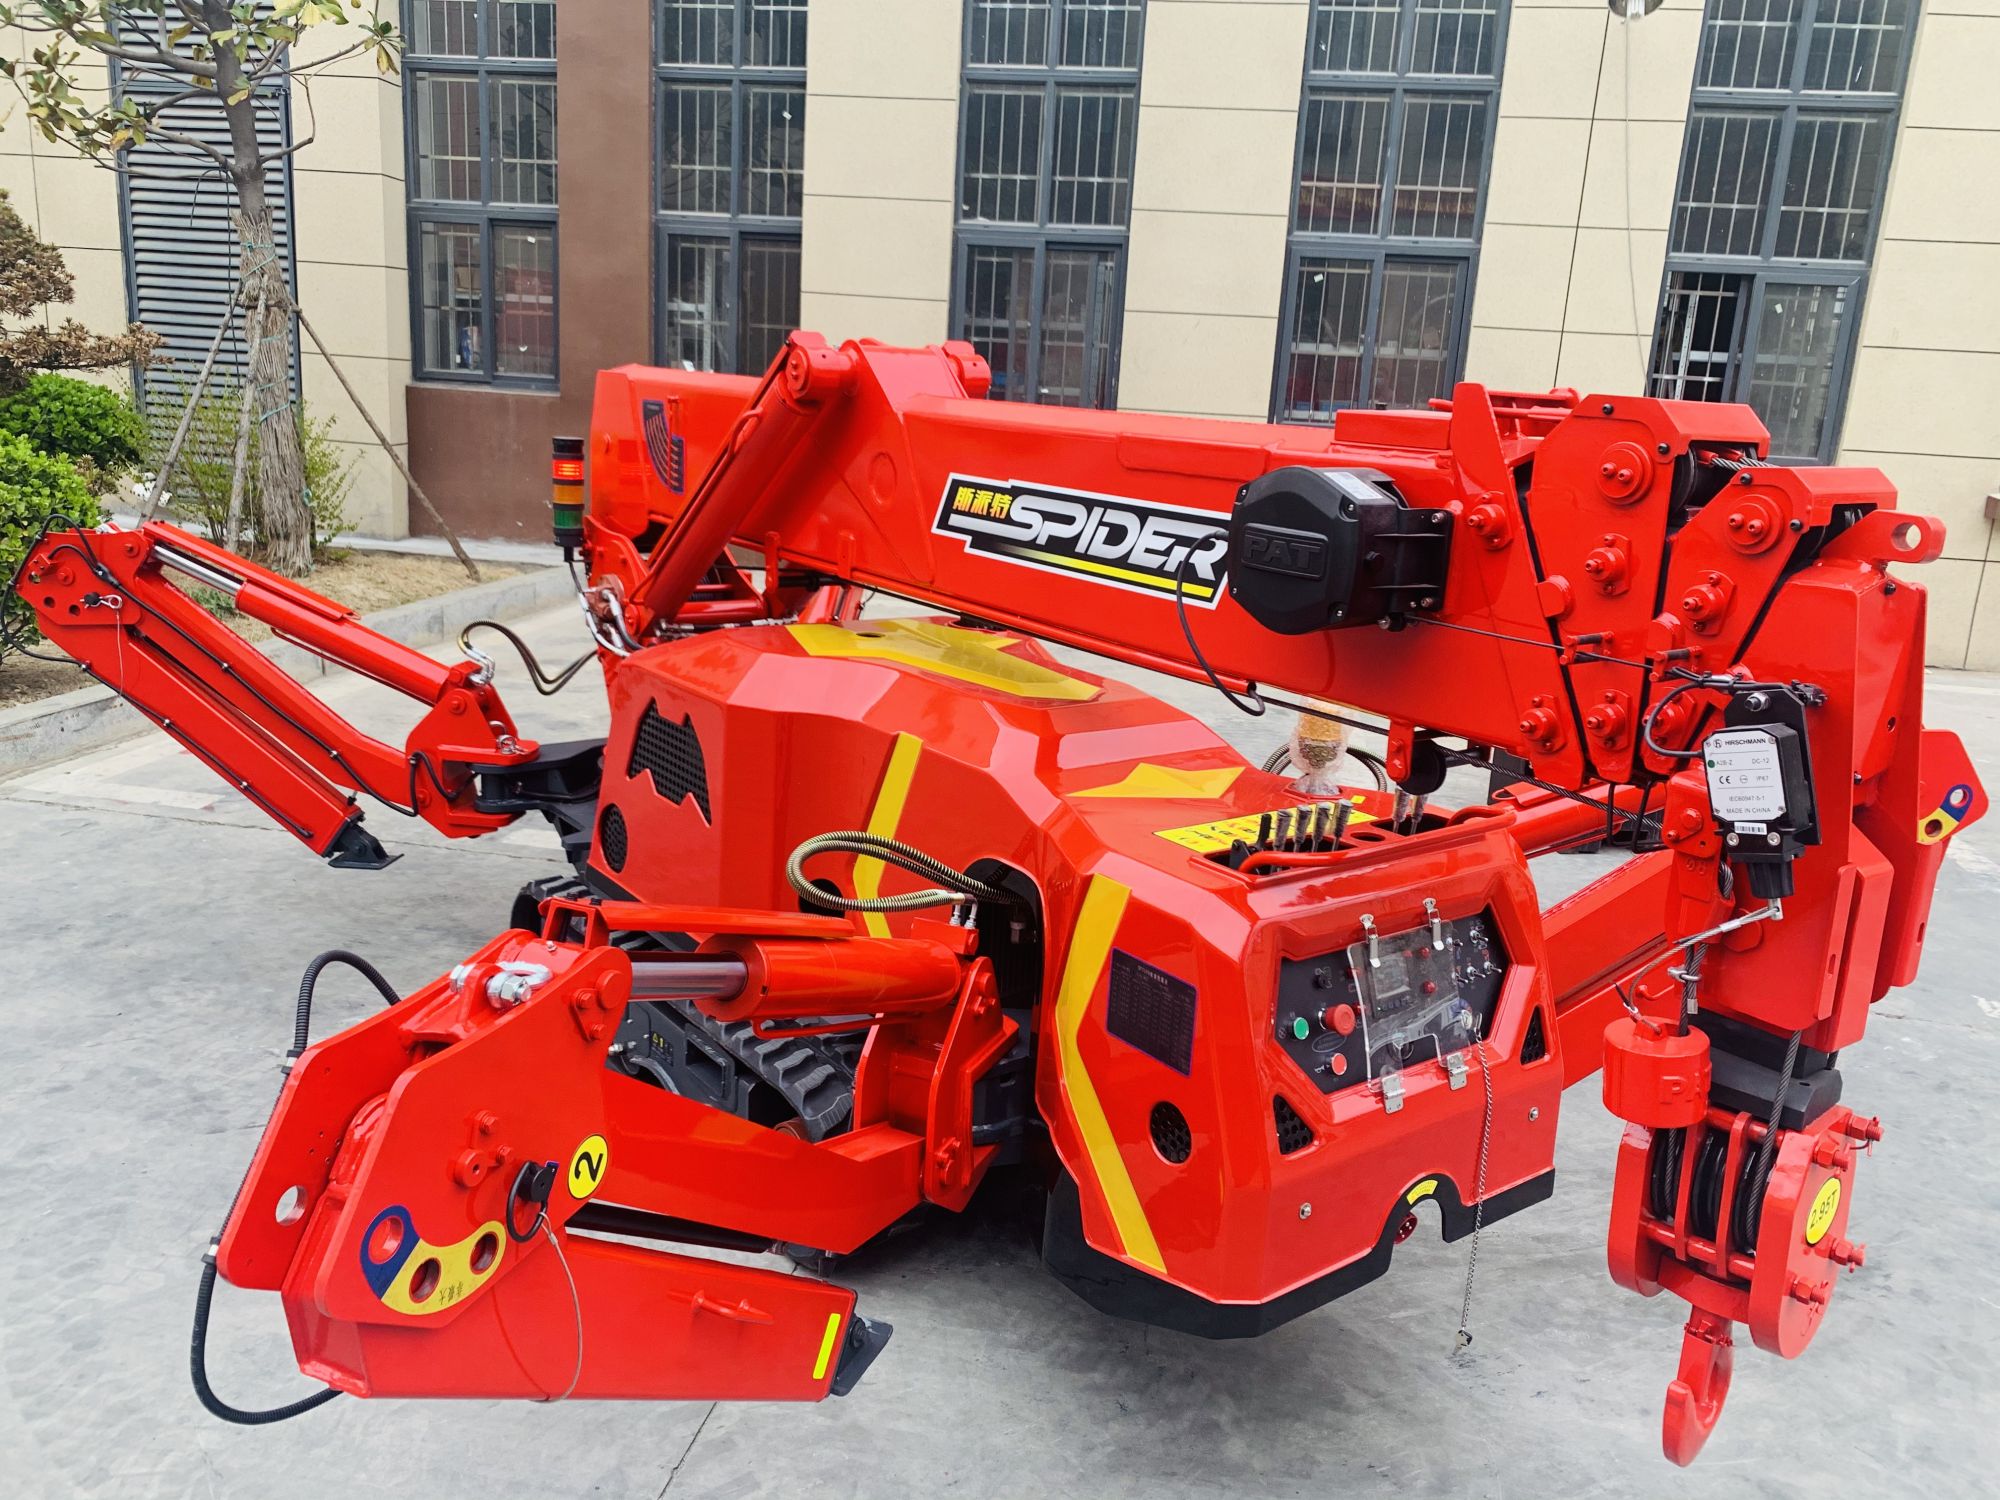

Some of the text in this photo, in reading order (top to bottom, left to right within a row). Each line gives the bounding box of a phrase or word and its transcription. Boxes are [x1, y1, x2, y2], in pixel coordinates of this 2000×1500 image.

[952, 486, 1013, 519] 斯派特
[948, 494, 1228, 581] SPIDER
[1243, 534, 1321, 570] PAT
[1724, 738, 1767, 746] HIRSCHMANN
[574, 1151, 603, 1182] 2
[1810, 1189, 1838, 1229] 2.95T
